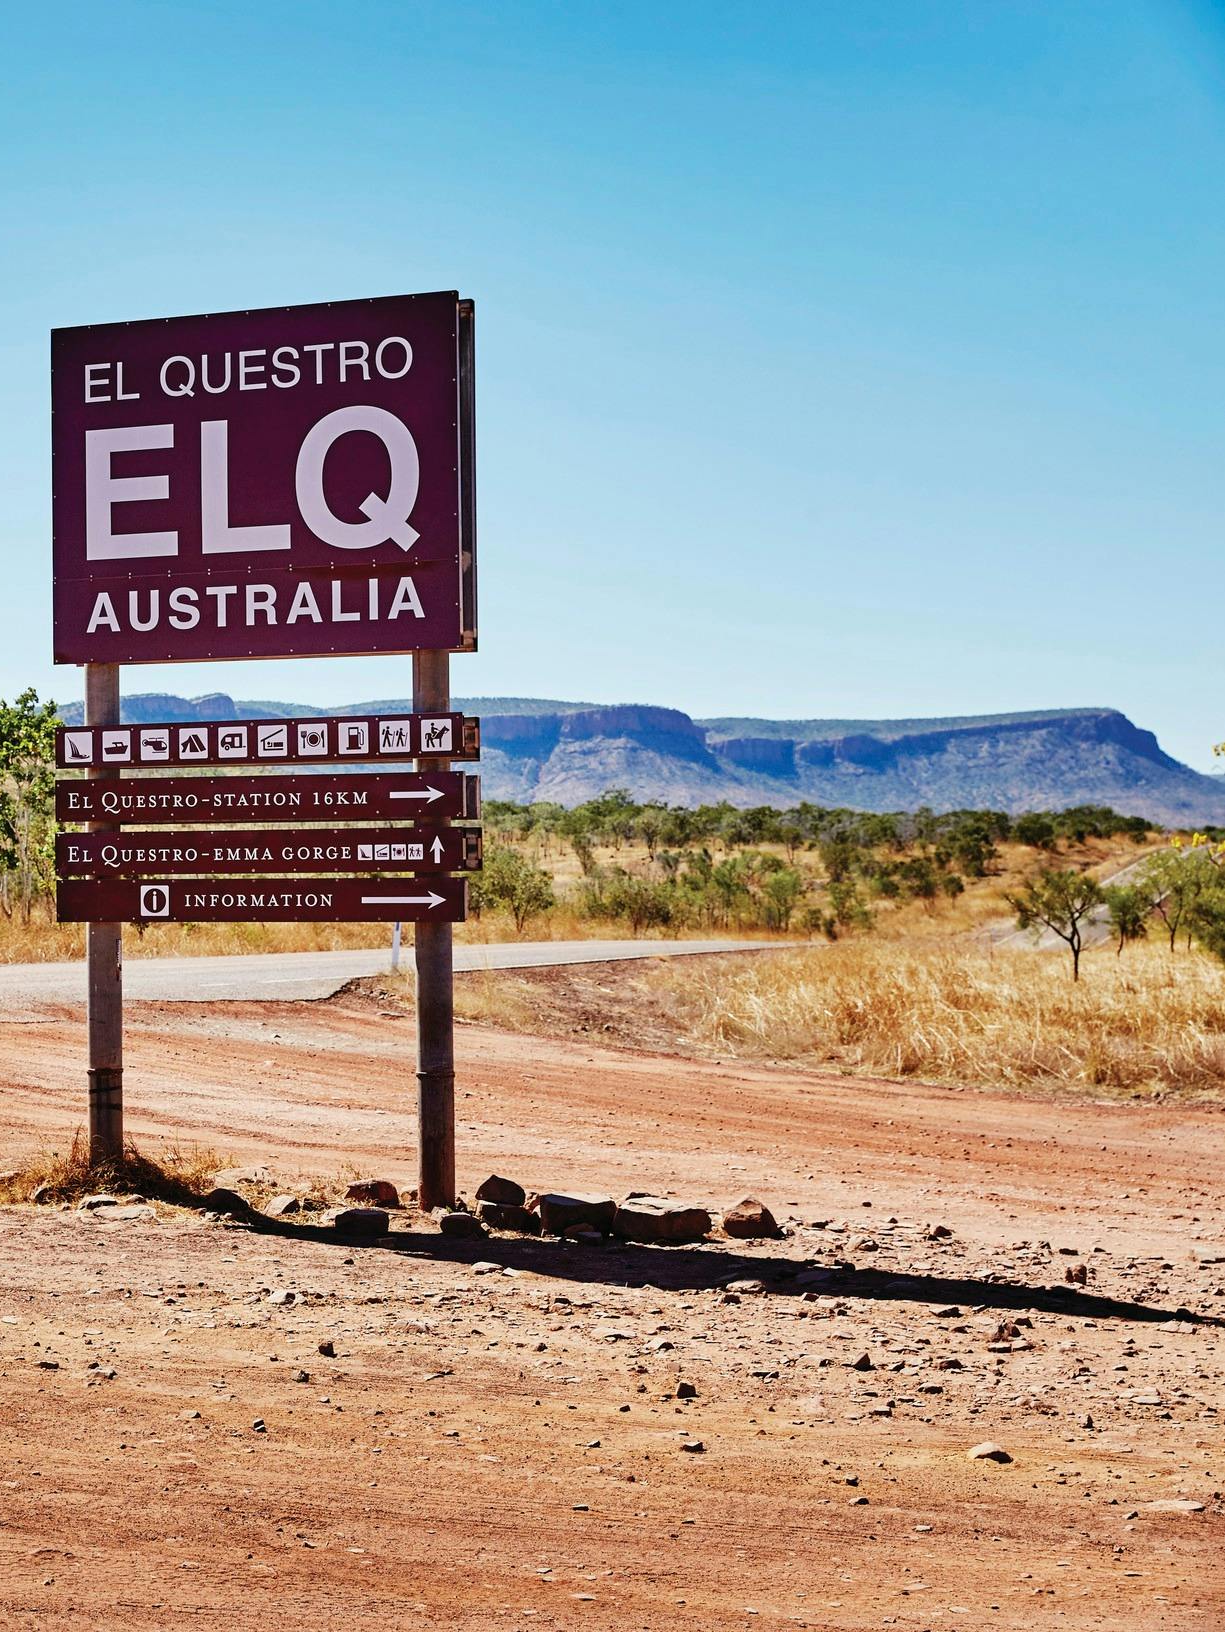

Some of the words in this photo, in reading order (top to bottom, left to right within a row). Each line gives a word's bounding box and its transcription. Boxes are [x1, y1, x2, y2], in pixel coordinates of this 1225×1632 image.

[84, 362, 140, 404] EL
[159, 336, 414, 398] QUESTRO
[85, 404, 421, 562] ELQ
[86, 576, 426, 634] AUSTRALIA
[313, 791, 369, 805] 16KM
[281, 846, 352, 860] GORGE
[184, 893, 333, 907] INFORMATION
